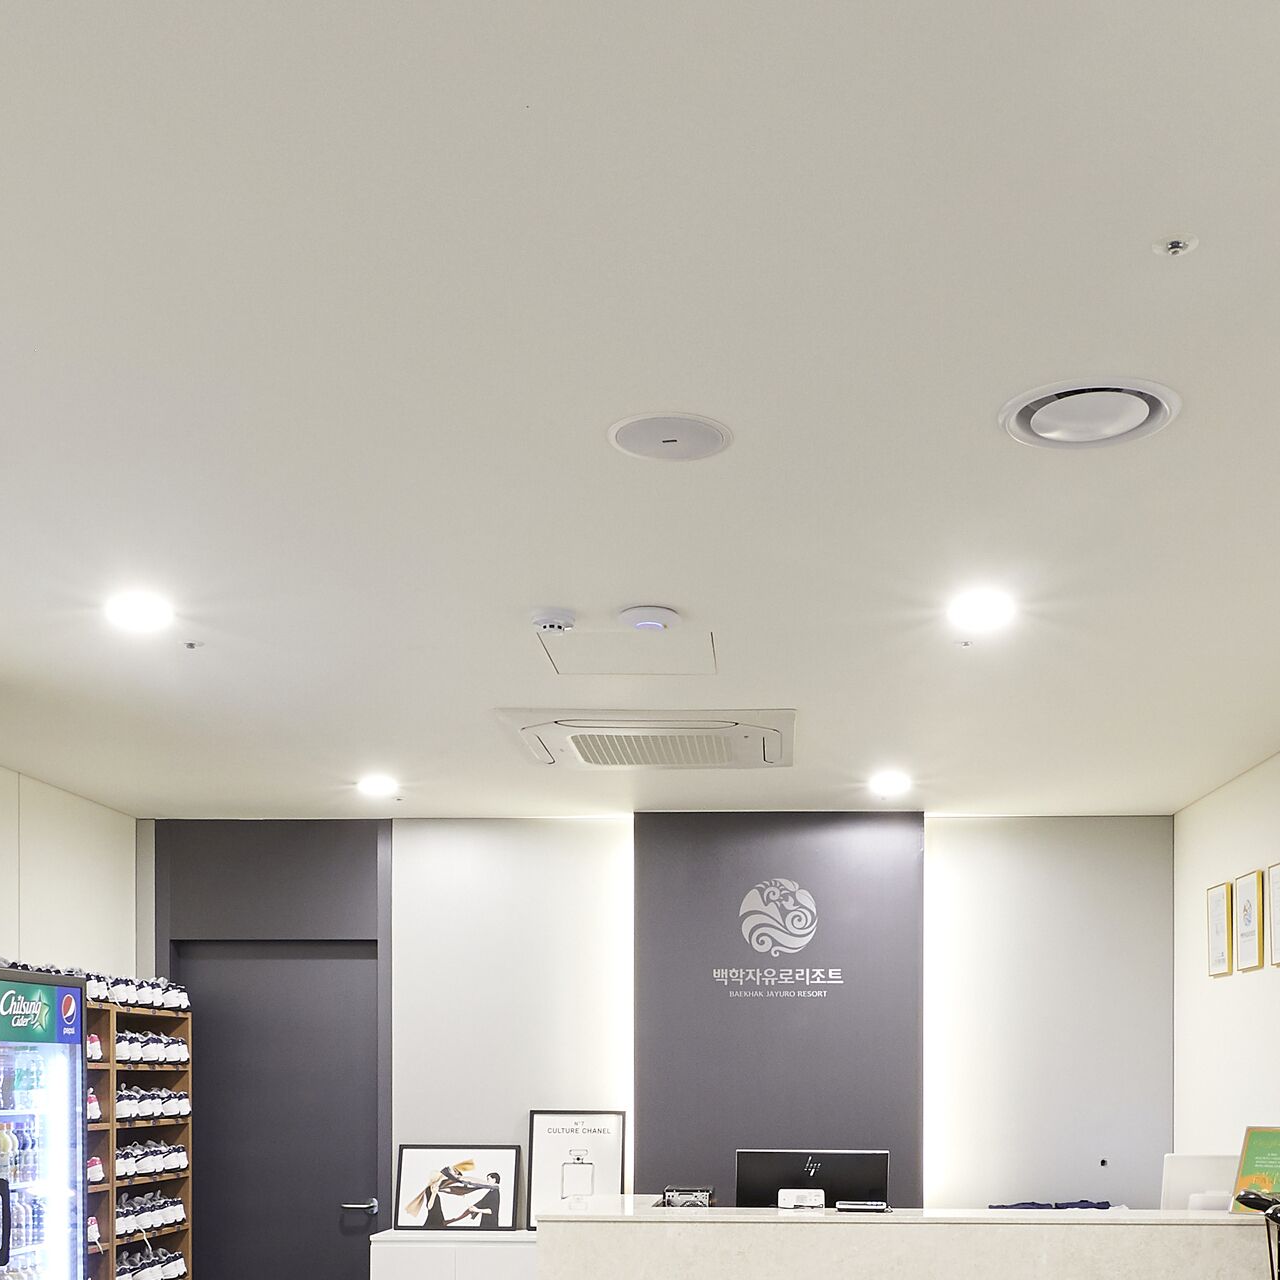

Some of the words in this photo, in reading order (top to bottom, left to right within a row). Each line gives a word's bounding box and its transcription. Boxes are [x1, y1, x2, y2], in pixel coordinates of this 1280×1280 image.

[712, 967, 845, 986] 백학자유로리조트
[729, 990, 763, 998] BAEKHAK
[765, 990, 796, 998] JAYURO
[797, 990, 828, 998] RESORT
[0, 989, 43, 1025] Chilsung
[546, 1127, 581, 1135] CULTURE
[581, 1127, 612, 1135] CHANEL
